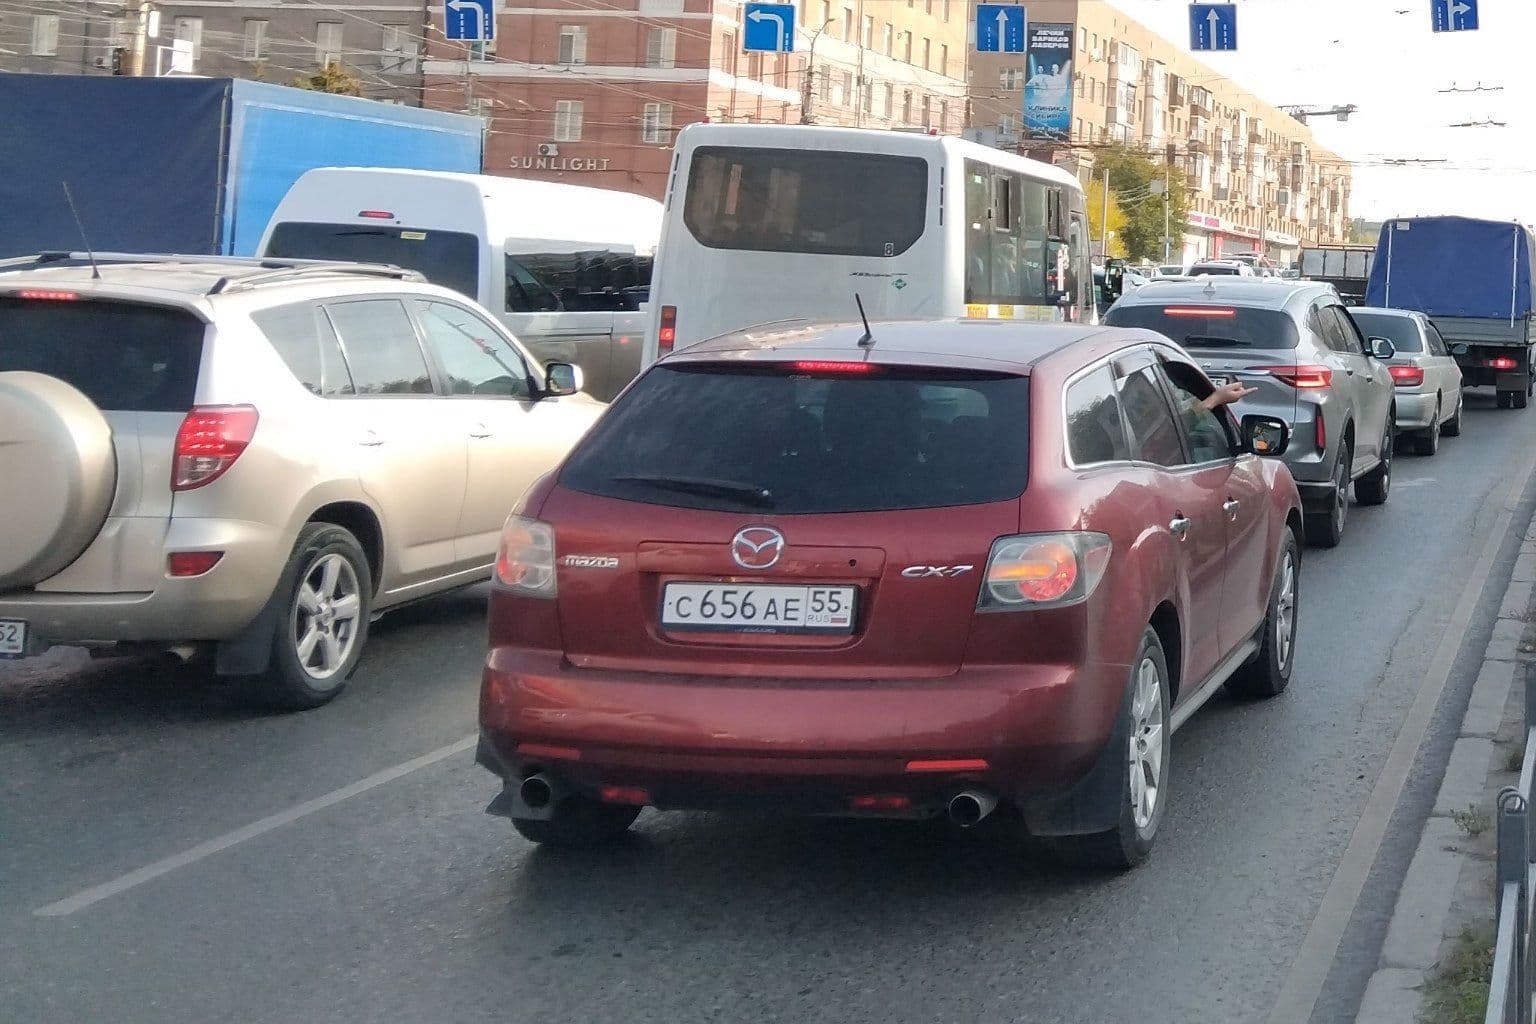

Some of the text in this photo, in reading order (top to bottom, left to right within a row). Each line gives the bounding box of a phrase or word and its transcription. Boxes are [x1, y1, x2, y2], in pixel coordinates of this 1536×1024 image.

[510, 155, 610, 171] SUNLIGHT
[565, 555, 619, 568] mazda
[901, 564, 974, 578] CX-7
[811, 591, 842, 613] 55
[807, 614, 831, 624] RUS
